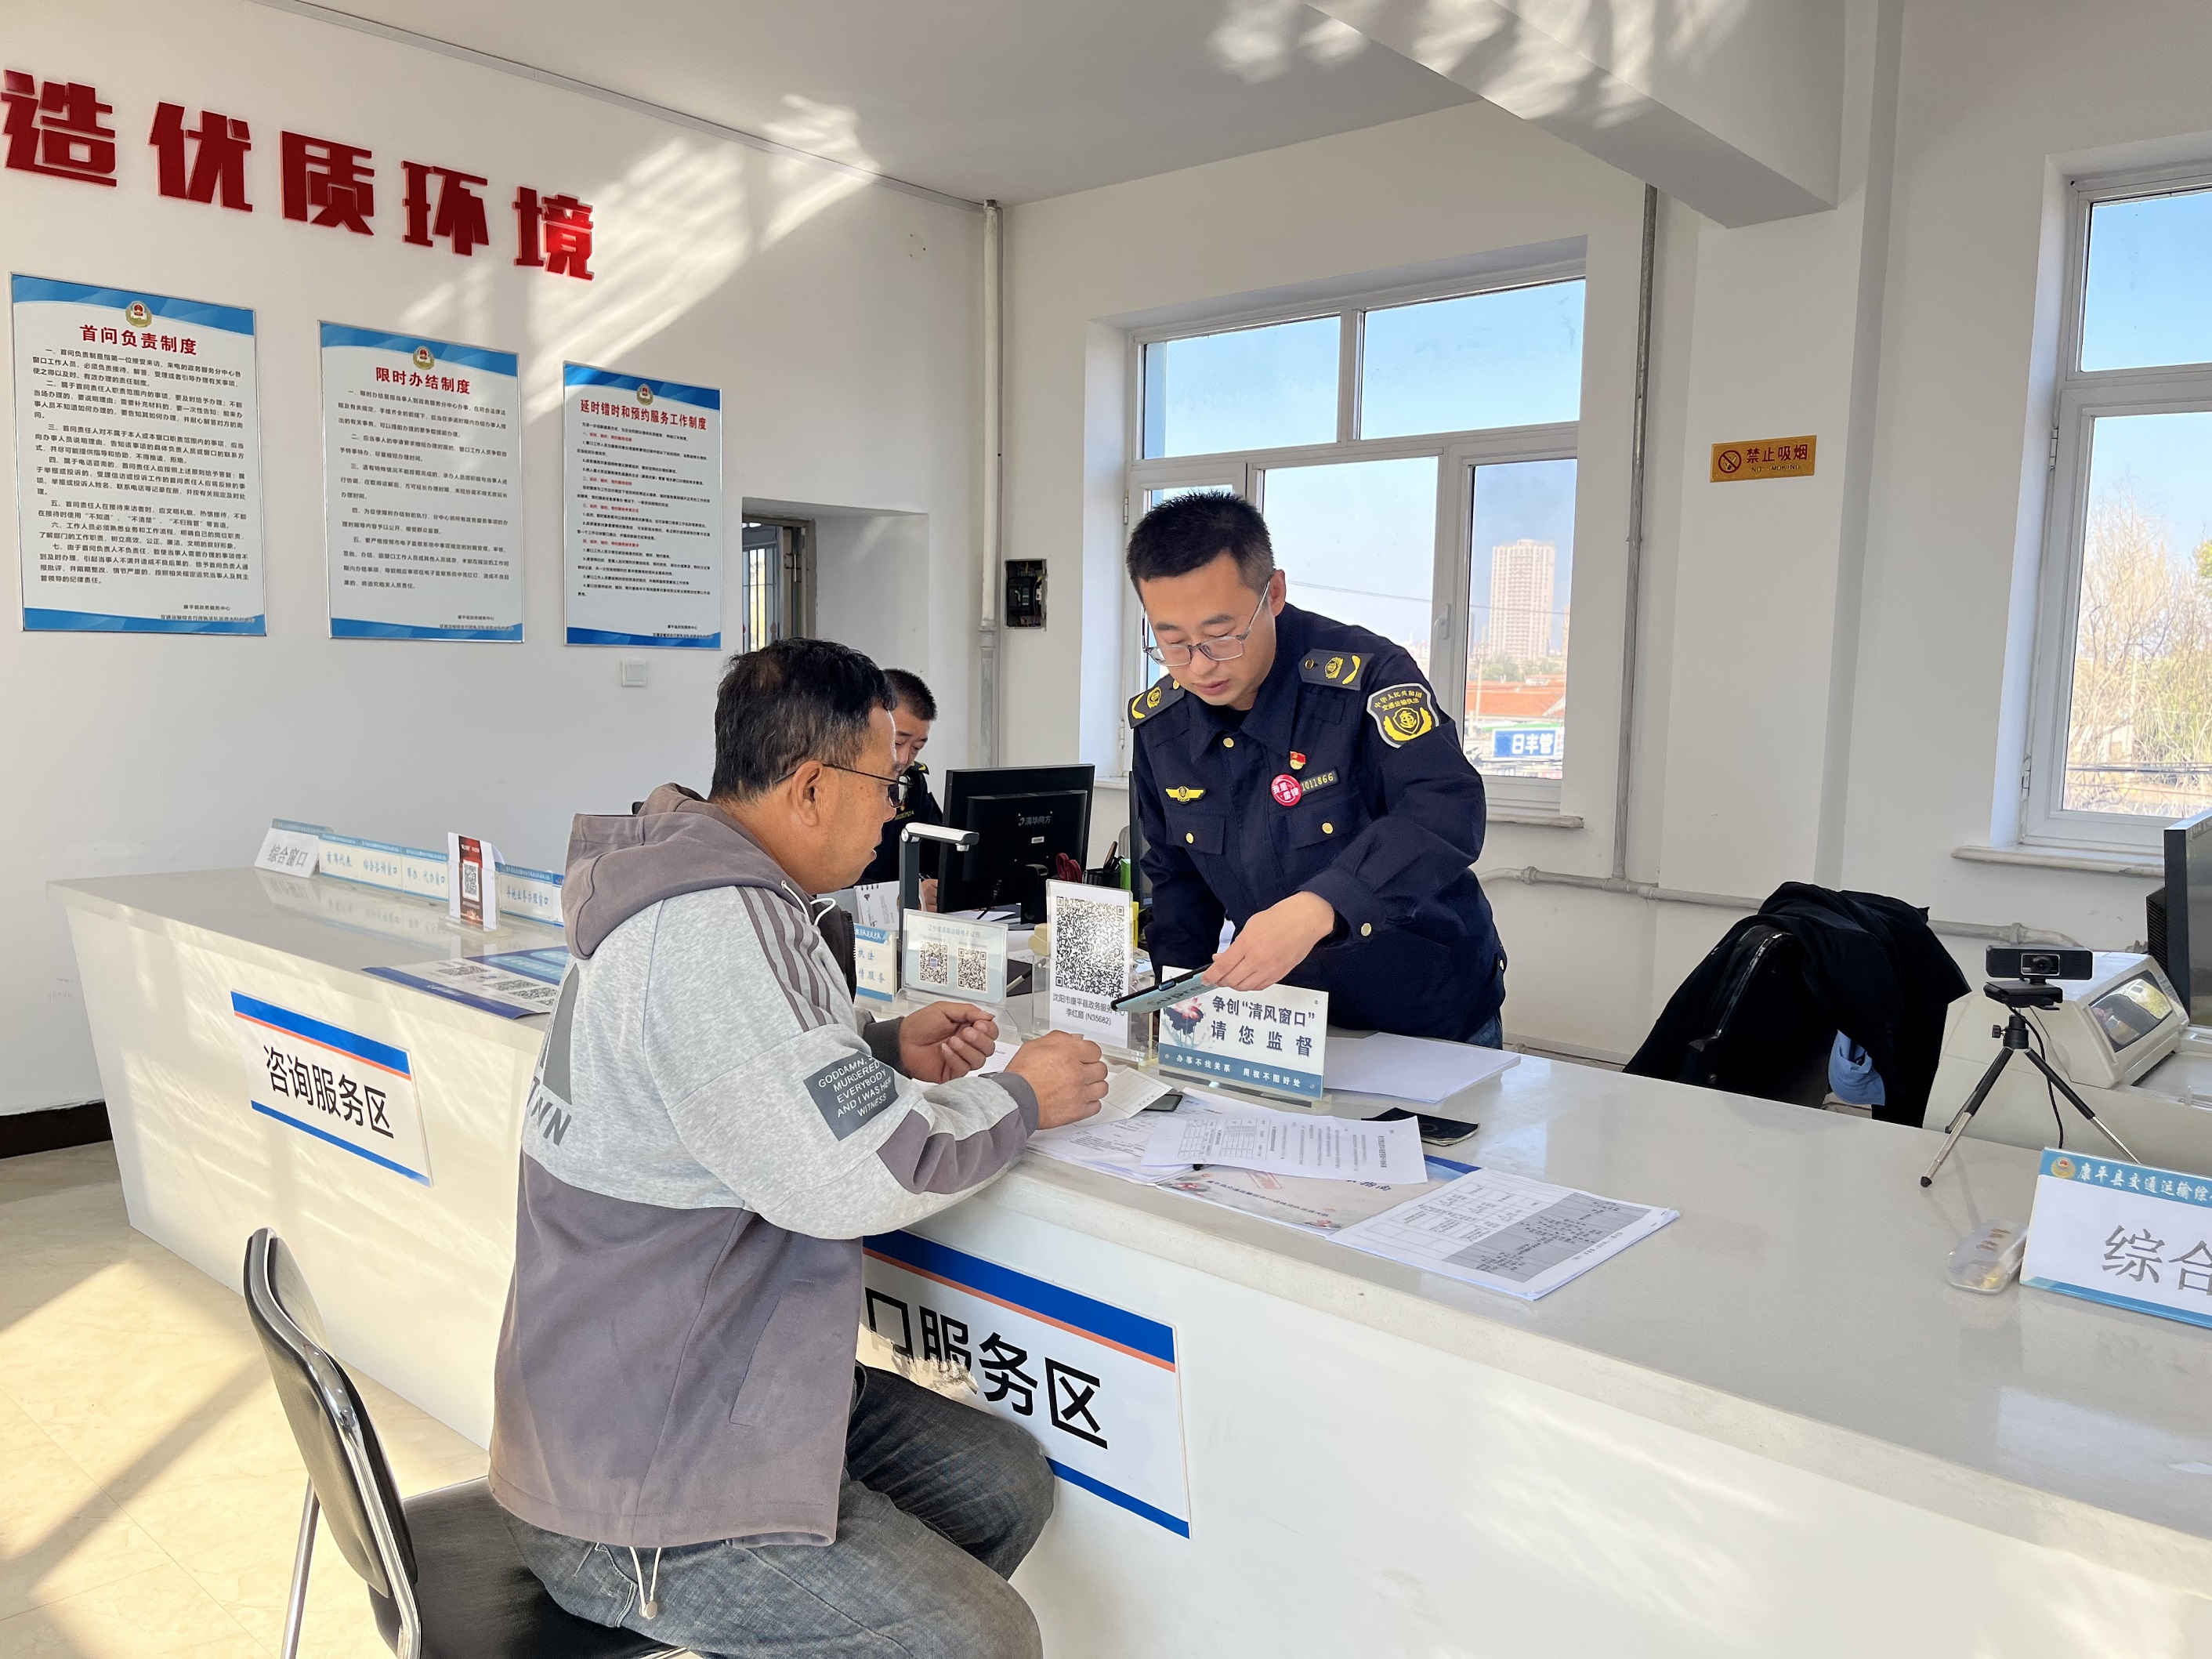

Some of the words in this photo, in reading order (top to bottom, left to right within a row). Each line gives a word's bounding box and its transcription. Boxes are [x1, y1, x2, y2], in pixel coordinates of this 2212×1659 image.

[0, 69, 594, 281] 造优质环境
[79, 324, 197, 355] 首问负责制度
[375, 367, 470, 394] 限时办结制度
[580, 399, 707, 430] 延时错时和预约服务工作制度
[1747, 444, 1808, 464] 禁止吸烟
[1374, 690, 1422, 708] 中华人民共和国
[1381, 697, 1420, 712] 交通运输执法
[1511, 733, 1554, 755] 日丰管
[1301, 773, 1334, 791] 1011866
[1024, 816, 1052, 825] 清华同方
[267, 844, 308, 867] 综合窗口
[1066, 1008, 1084, 1020] 李红顺
[1085, 1012, 1111, 1026] (N35682)
[1212, 996, 1316, 1027] 争创“清风窗口”
[1211, 1020, 1312, 1058] 请您监督
[833, 1060, 880, 1092] MURDERED
[837, 1068, 886, 1103] EVERYBODY
[1176, 1054, 1230, 1073] 办事不找关系
[1243, 1067, 1301, 1088] 用权不图好处
[263, 1045, 394, 1139] 咨询服务区
[838, 1099, 857, 1118] AND
[861, 1085, 881, 1102] WAS
[856, 1092, 887, 1117] WITNESS
[2077, 1162, 2212, 1201] 康平县交通运输综
[2102, 1225, 2212, 1295] 综合
[865, 1287, 1108, 1450] 口服务区
